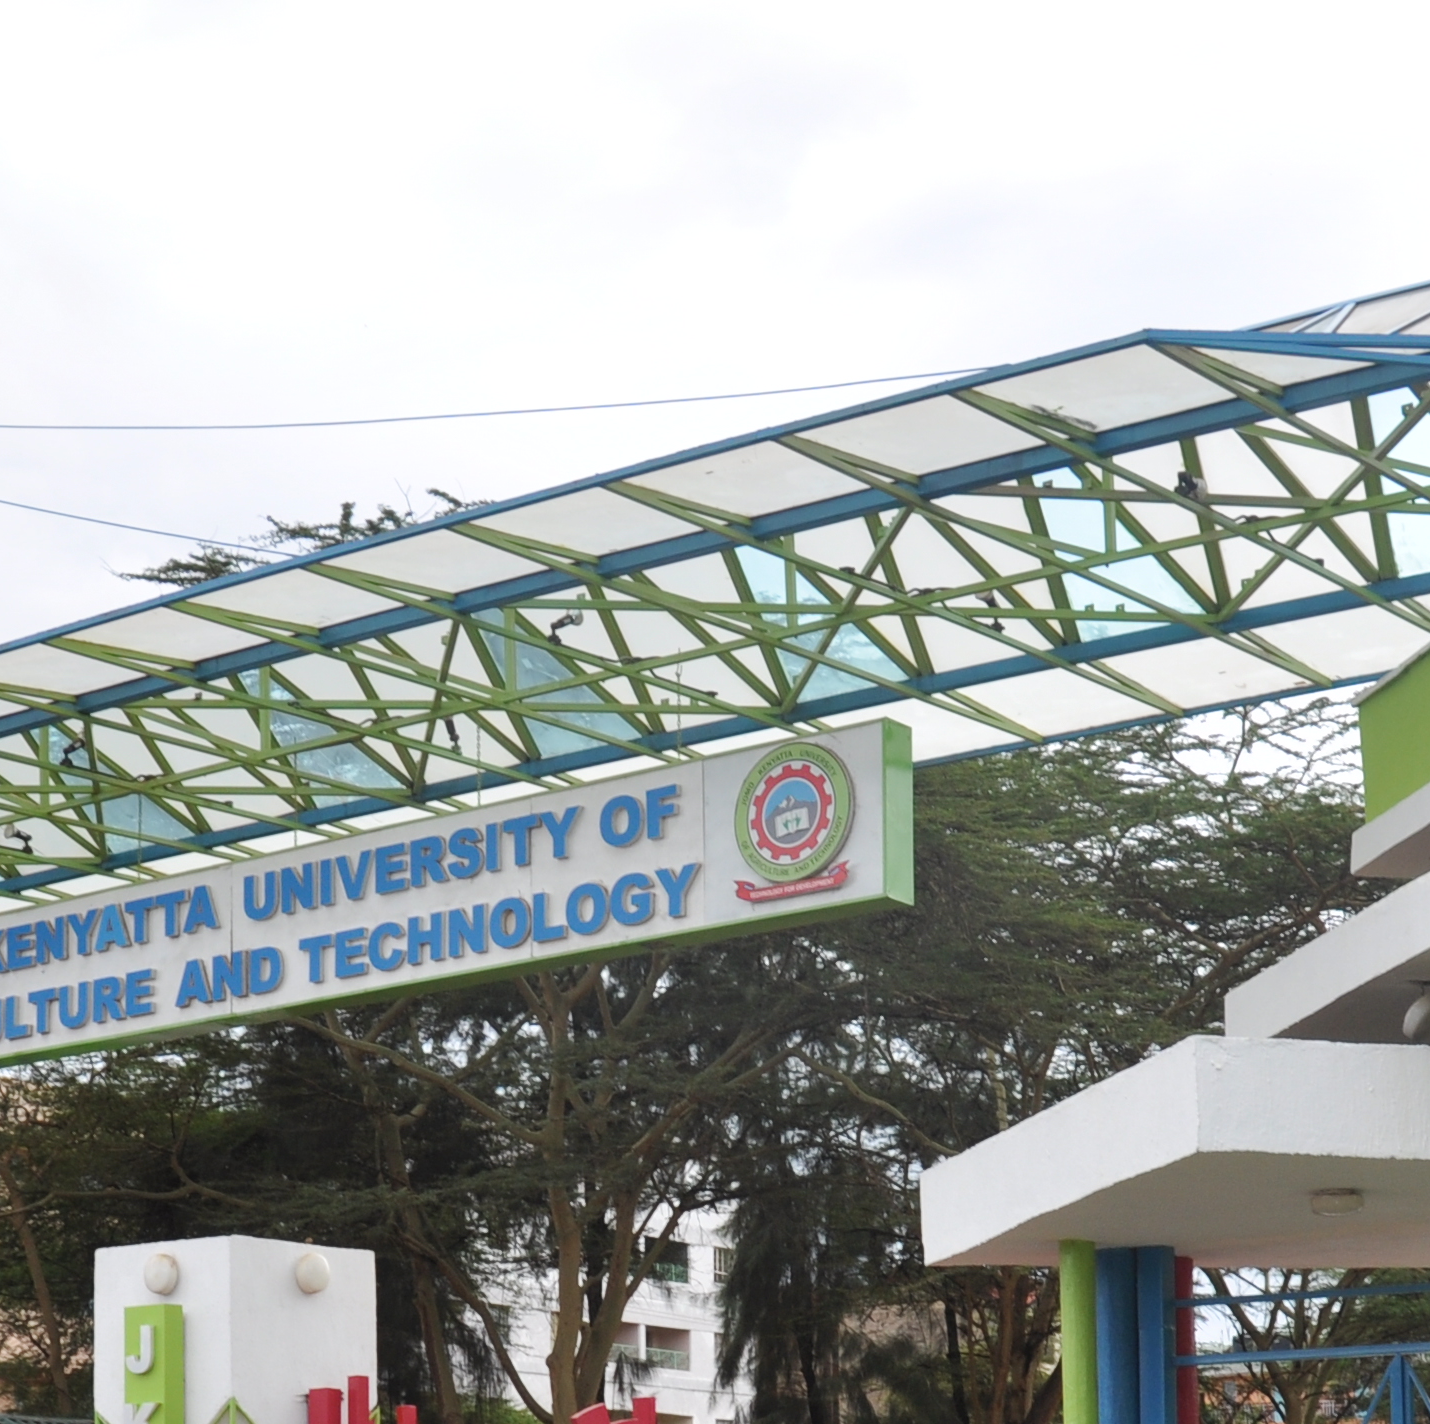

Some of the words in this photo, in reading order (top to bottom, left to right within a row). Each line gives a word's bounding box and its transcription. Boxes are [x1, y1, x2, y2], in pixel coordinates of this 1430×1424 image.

[243, 806, 580, 921] UNIVERSITY
[600, 784, 680, 848] OF
[175, 945, 283, 1008] AND
[299, 862, 700, 984] TECHNOLOGY
